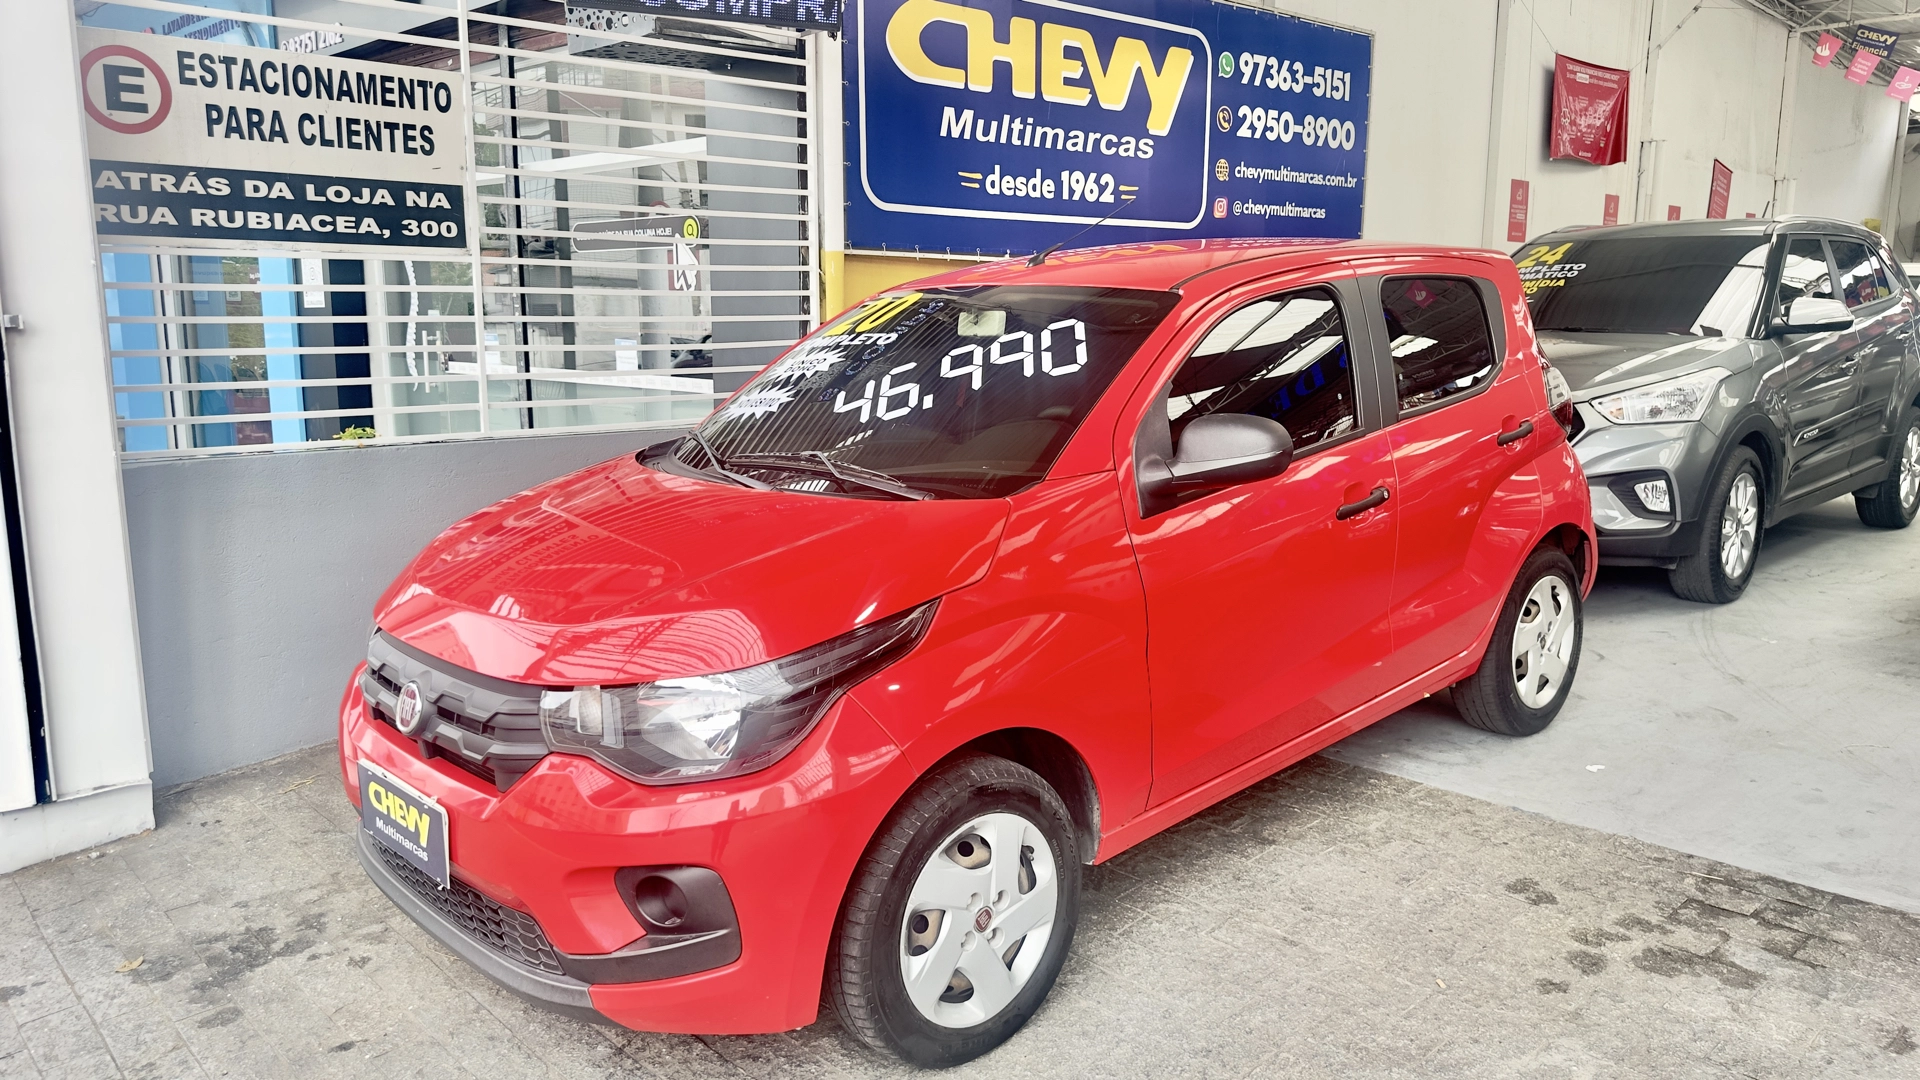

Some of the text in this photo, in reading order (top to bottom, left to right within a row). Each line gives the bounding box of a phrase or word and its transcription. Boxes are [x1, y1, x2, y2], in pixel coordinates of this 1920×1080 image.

[1856, 29, 1898, 46] CHEVY
[102, 63, 150, 114] E
[176, 50, 452, 114] ESTACIONAMENTO
[886, 0, 1195, 137] CHEVY
[1238, 51, 1352, 102] 97363-5151
[205, 103, 436, 157] PARA CLIENTES
[939, 106, 1156, 160] Multimarcas
[1236, 104, 1356, 151] 2950-8900
[94, 171, 452, 209] ATRÁS DA LOJA NA
[985, 164, 1116, 203] desde 1962
[1234, 161, 1358, 189] chevymultimarcas.com.br
[95, 203, 459, 239] RUA RUBIACEA, 300
[1516, 242, 1574, 268] 24
[1517, 263, 1587, 274] MPLETO
[822, 292, 924, 337] 20
[833, 318, 1088, 424] 46.990
[368, 781, 430, 849] CHEVY
[376, 816, 429, 862] Multimarcas
